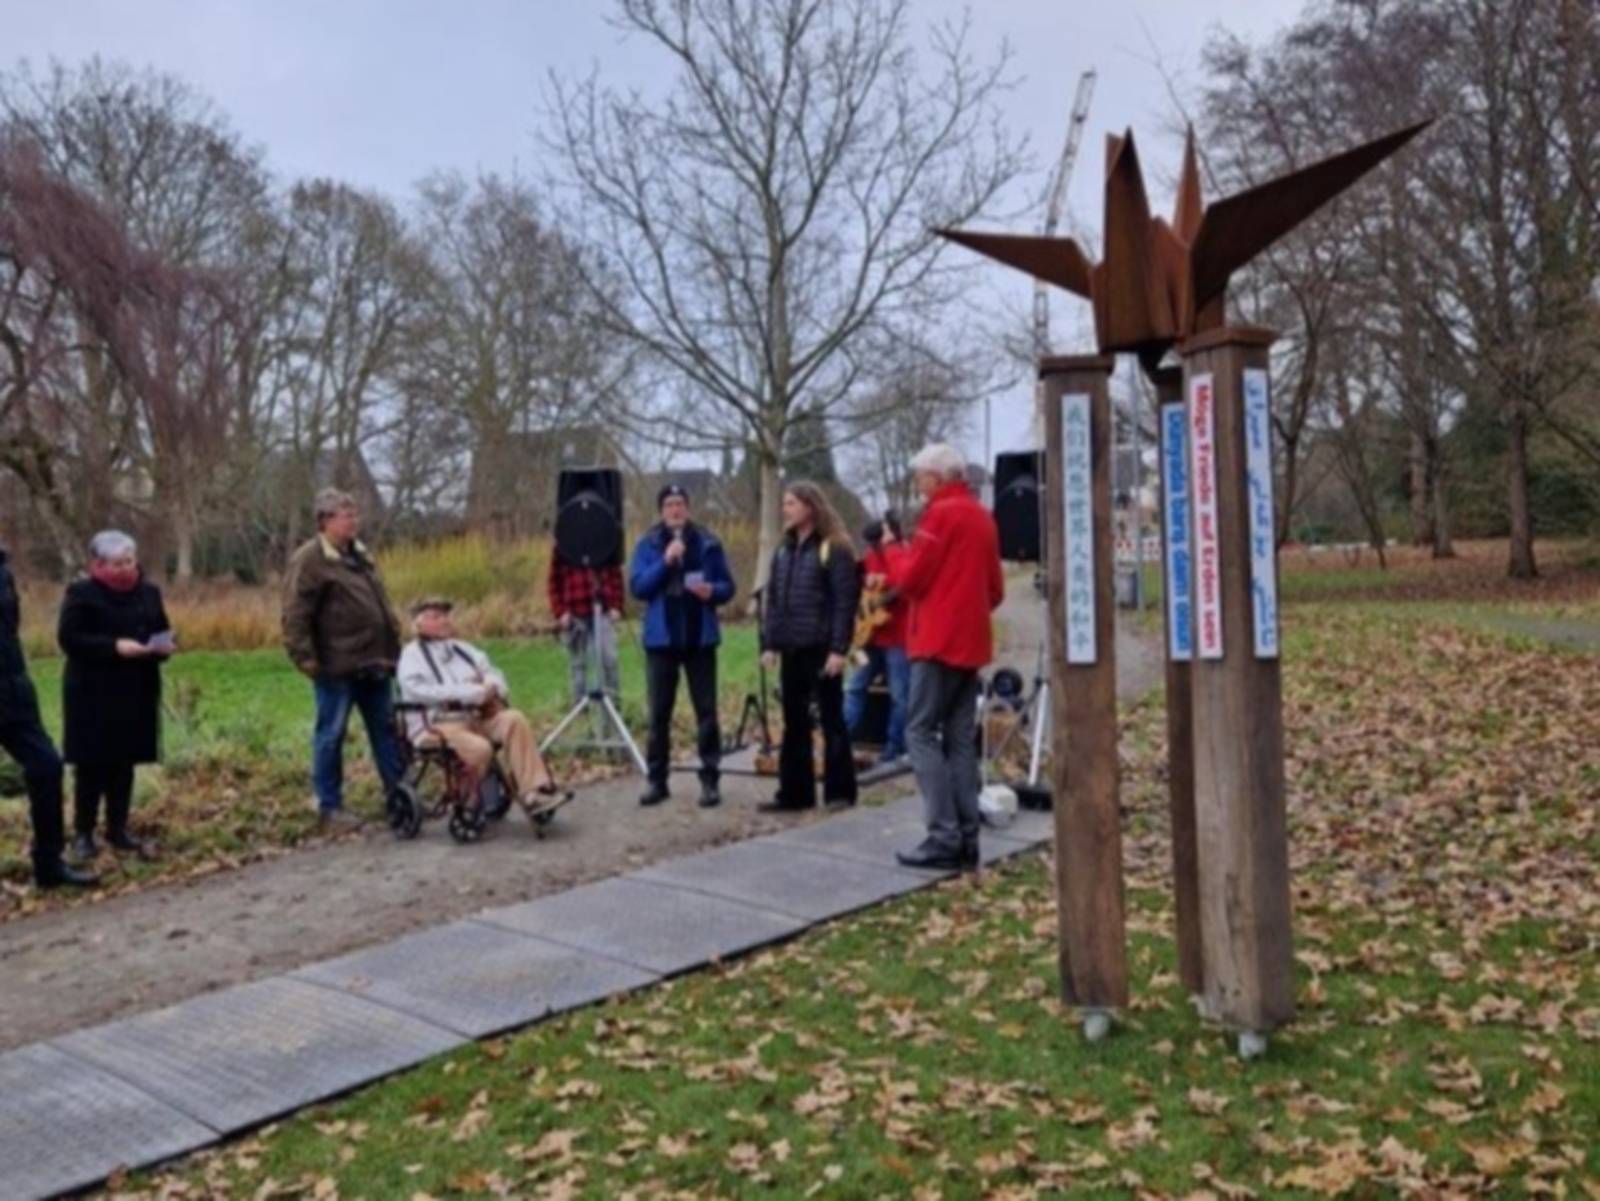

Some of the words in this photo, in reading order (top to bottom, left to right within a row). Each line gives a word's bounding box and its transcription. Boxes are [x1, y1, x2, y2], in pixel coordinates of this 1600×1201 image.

[1198, 443, 1212, 504] Friede
[1200, 511, 1214, 541] auf
[1202, 546, 1216, 604] Erden
[1203, 610, 1217, 649] sein
